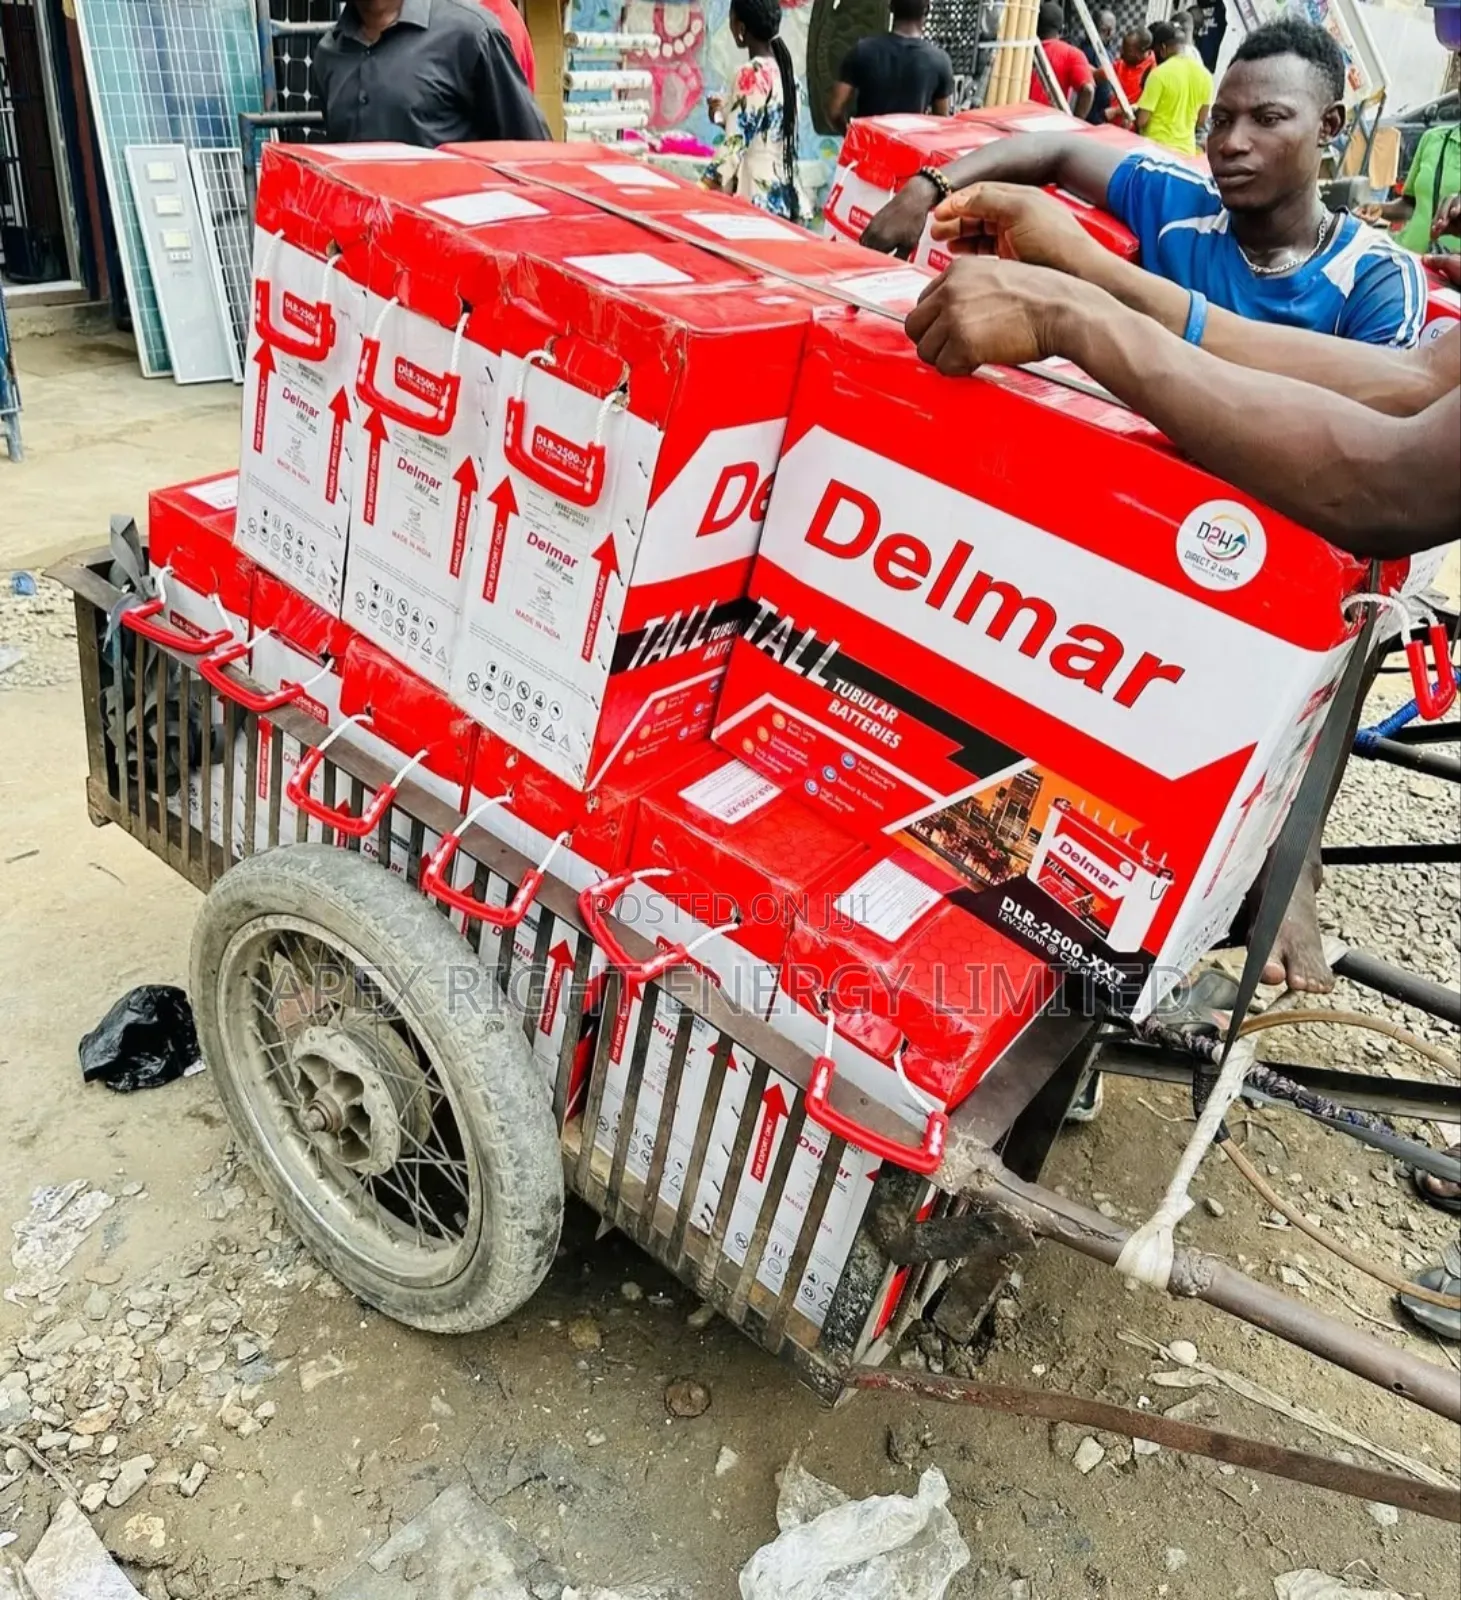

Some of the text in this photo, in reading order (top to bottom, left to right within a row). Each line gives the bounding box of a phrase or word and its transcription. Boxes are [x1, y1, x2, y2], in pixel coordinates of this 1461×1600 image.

[282, 387, 319, 419] Delmar
[397, 456, 443, 490] Delmar
[527, 531, 579, 569] Delmar
[1196, 520, 1233, 550] D2H
[489, 545, 500, 579] EXPORT
[1184, 550, 1210, 566] DIRECT
[1218, 565, 1240, 581] HOME
[485, 580, 494, 599] FOR
[804, 479, 1185, 709] Delmar
[515, 609, 534, 625] MADE
[544, 625, 561, 641] INDIA
[627, 599, 718, 672] TALL
[744, 597, 899, 724] TALL TUBULAR
[828, 699, 902, 748] BATTERIES
[1058, 840, 1120, 891] Delmar
[997, 908, 1046, 948] 12V-220Ah
[1047, 943, 1058, 955] @
[1059, 952, 1080, 968] C20
[1000, 896, 1127, 986] DLR-2500-XXT
[754, 1117, 773, 1179] FOR EXPORT ONLY
